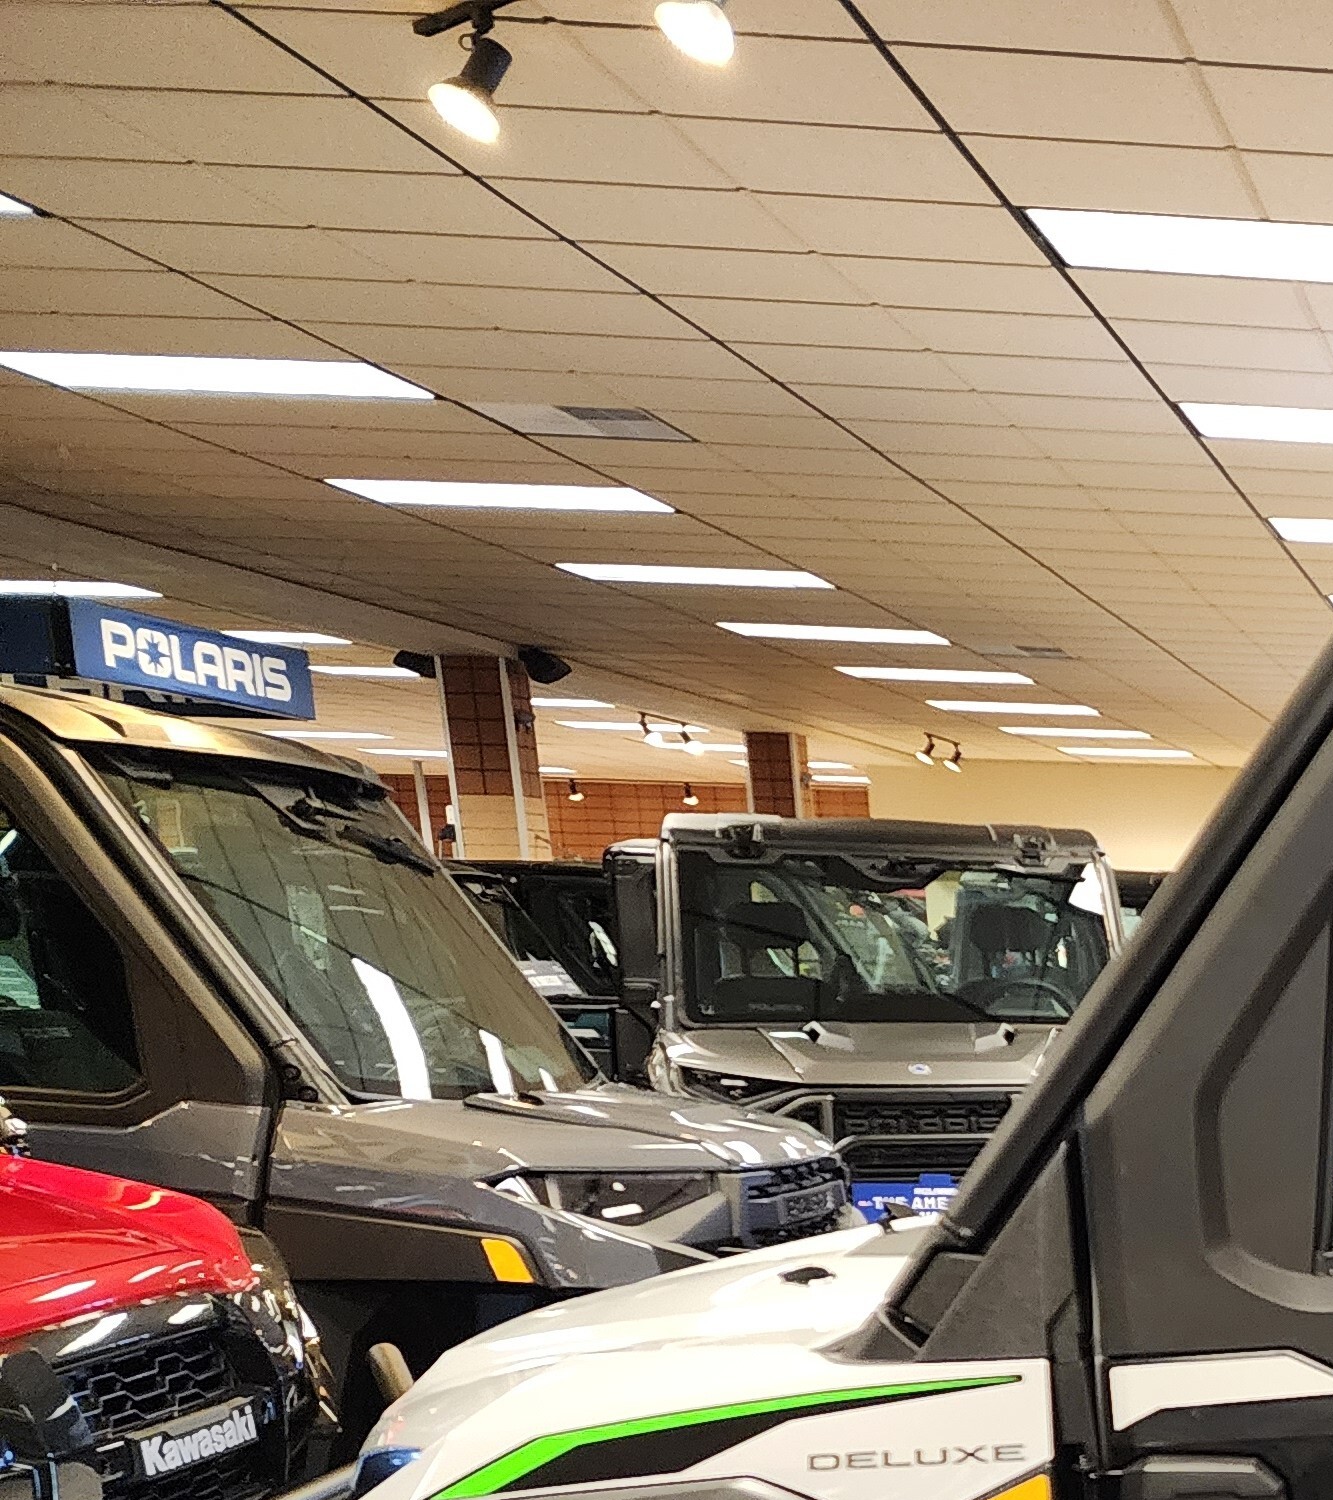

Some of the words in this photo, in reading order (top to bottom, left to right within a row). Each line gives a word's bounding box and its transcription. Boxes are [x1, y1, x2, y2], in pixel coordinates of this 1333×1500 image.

[100, 618, 292, 703] POLARIS
[141, 1405, 257, 1476] Kawasaki
[807, 1443, 1026, 1471] DELUXE
